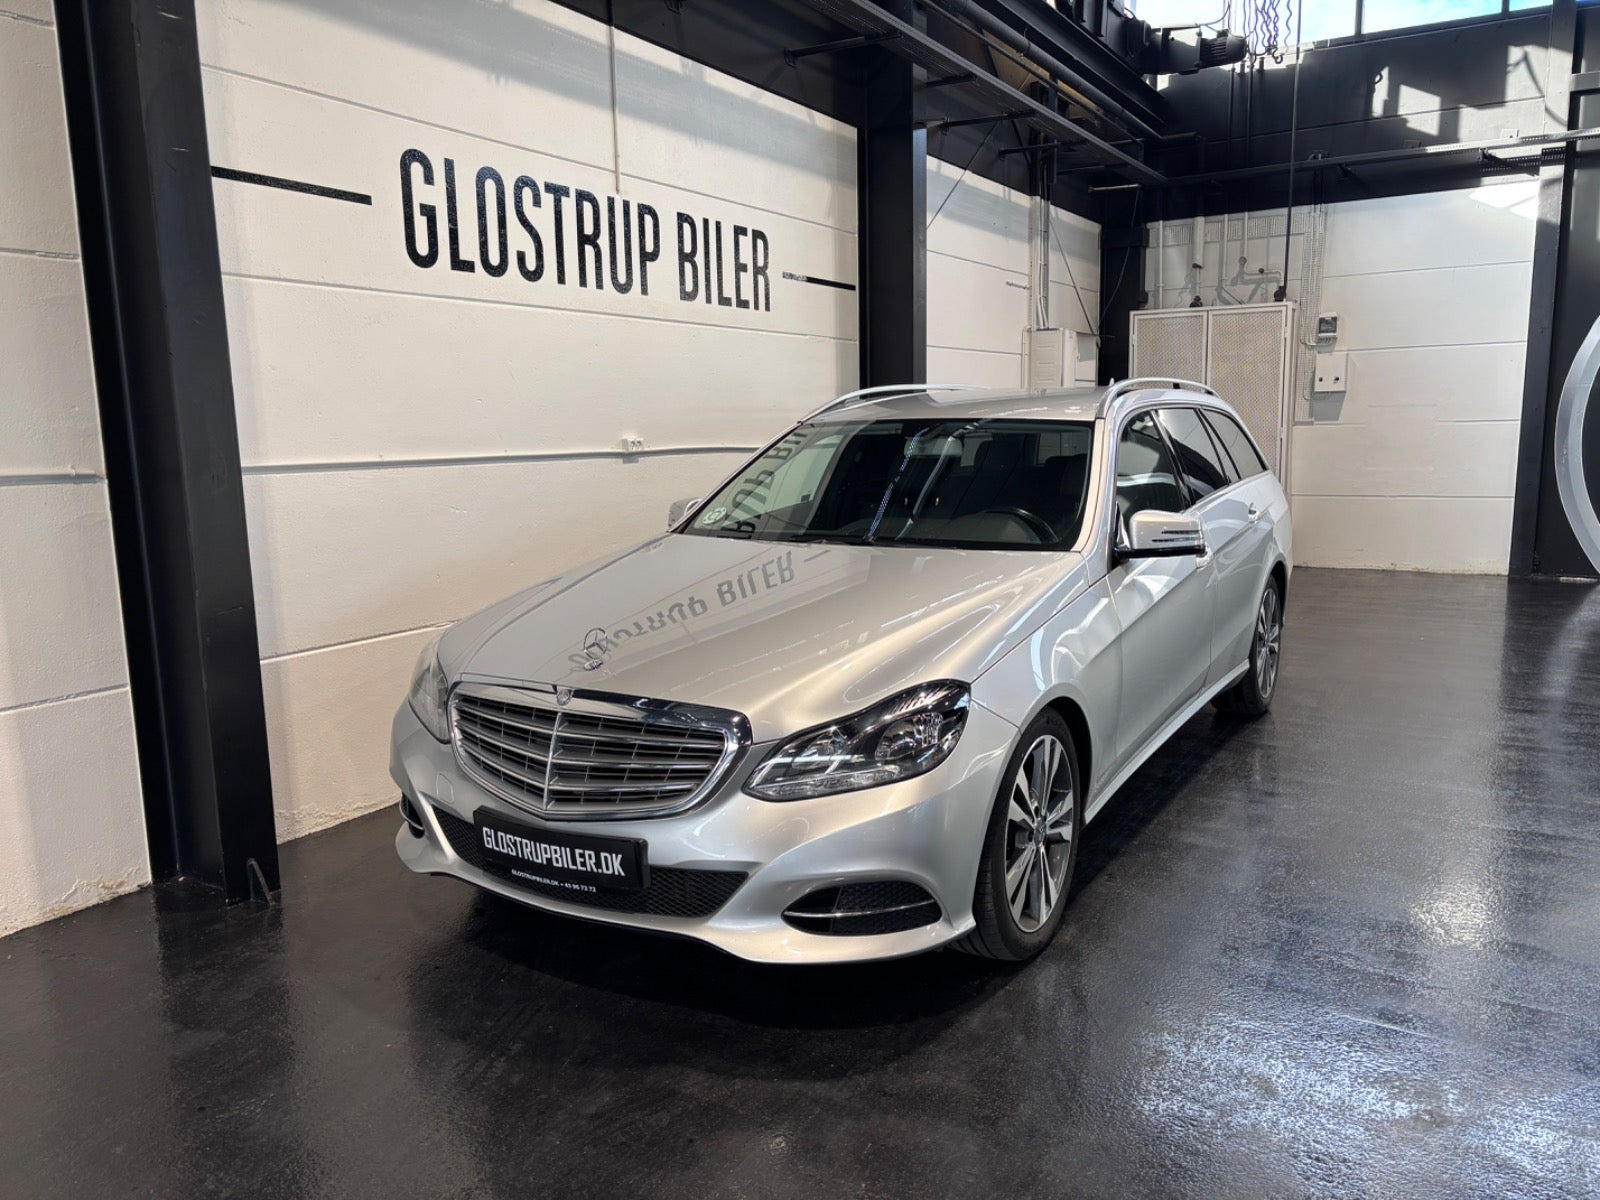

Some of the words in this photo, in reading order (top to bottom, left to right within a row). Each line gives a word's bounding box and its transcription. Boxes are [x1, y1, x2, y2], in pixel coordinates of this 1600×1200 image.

[399, 148, 661, 296] GLOSTRUP
[678, 211, 772, 312] BILER
[482, 826, 626, 877] GLOSTRUPBILER.DK
